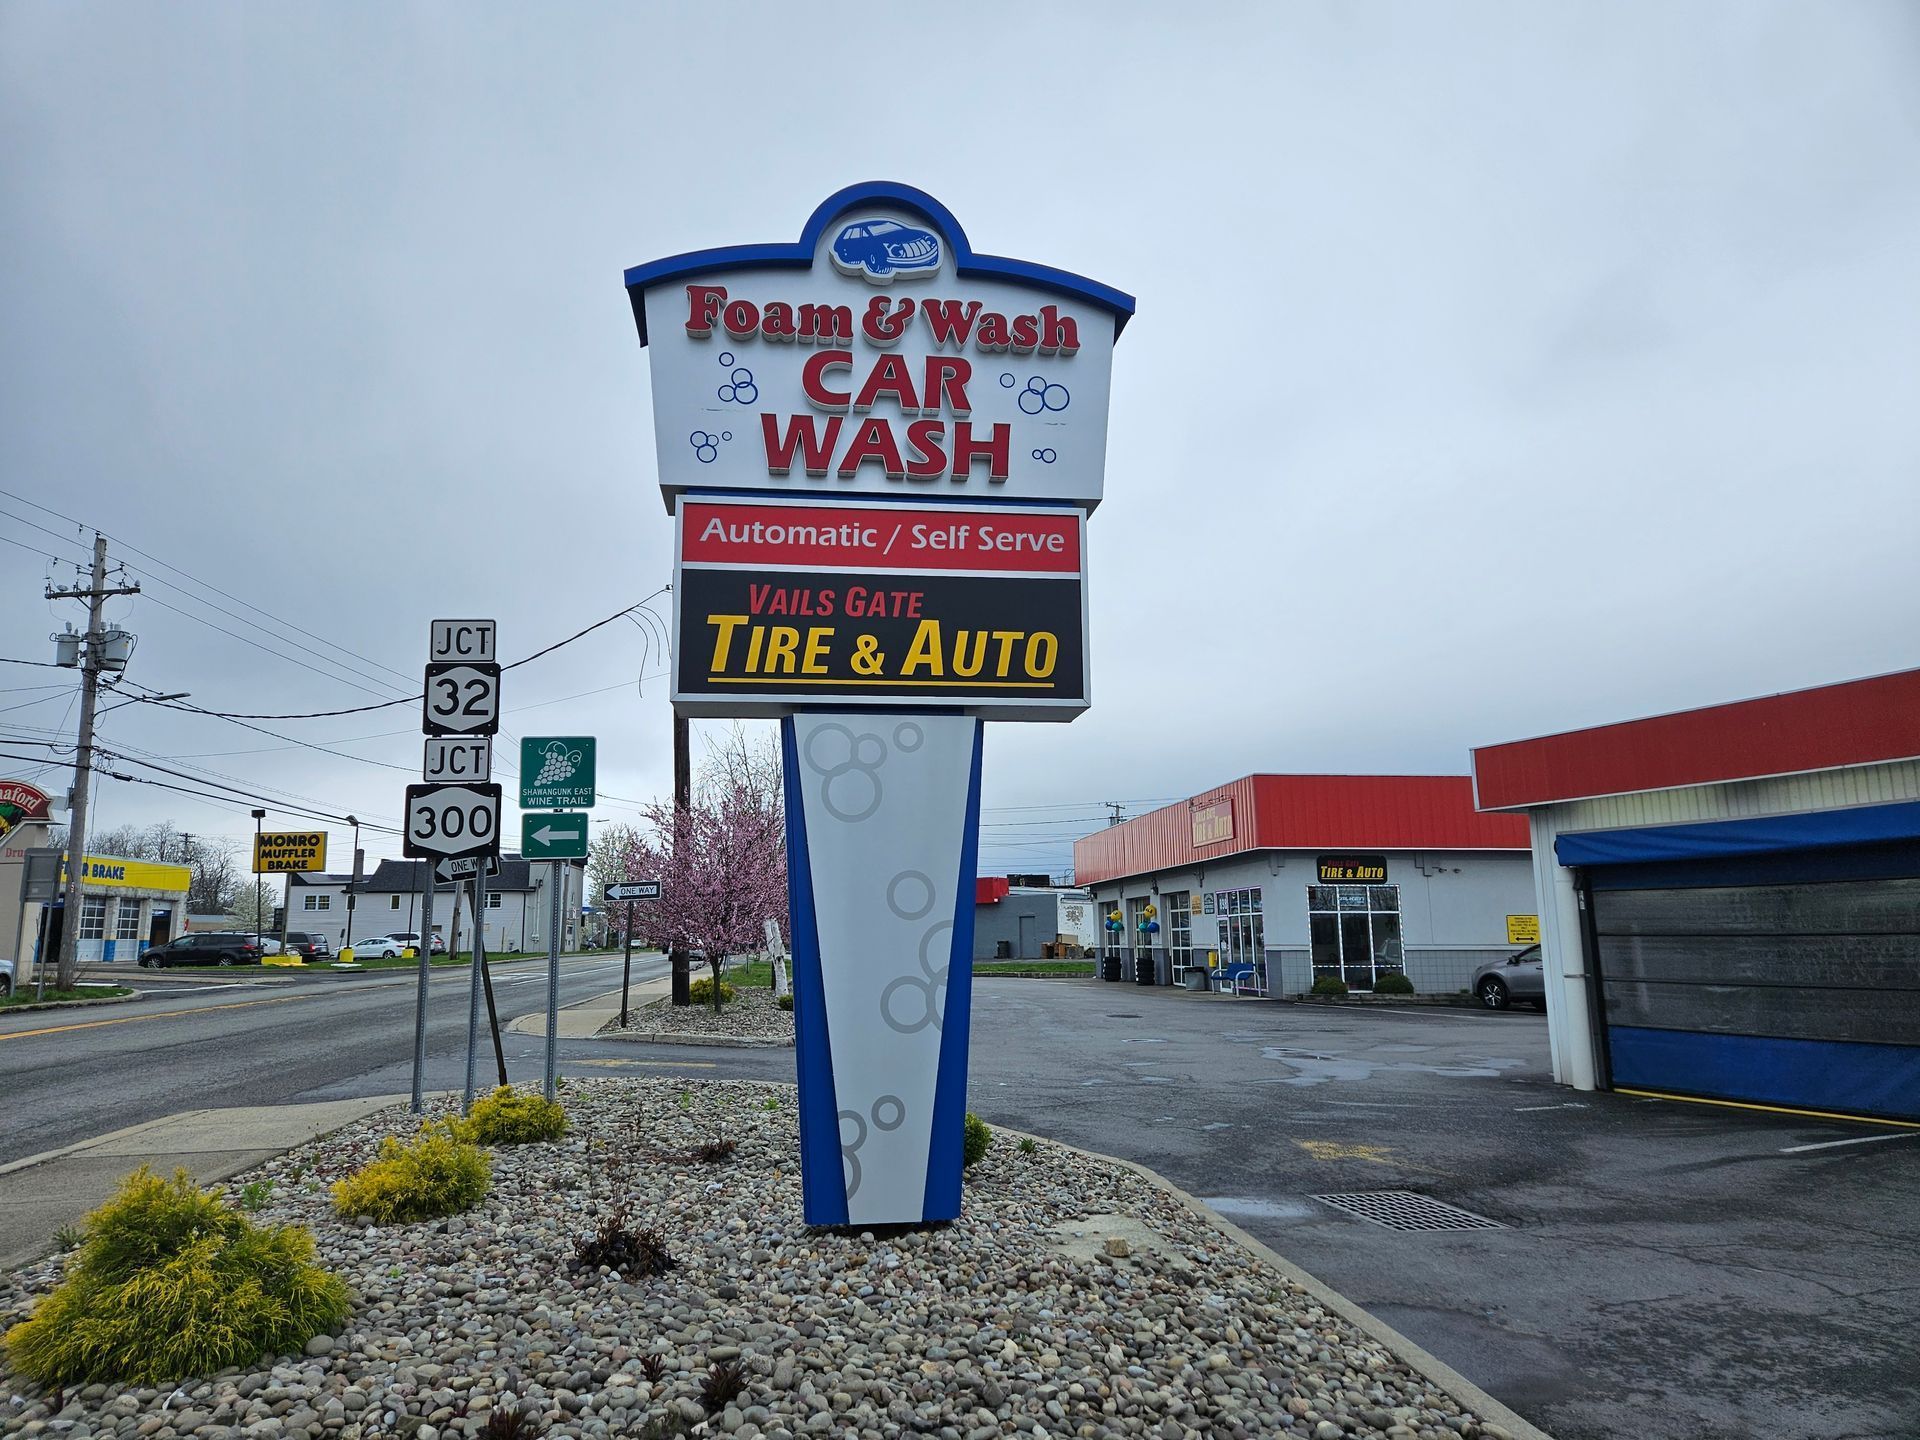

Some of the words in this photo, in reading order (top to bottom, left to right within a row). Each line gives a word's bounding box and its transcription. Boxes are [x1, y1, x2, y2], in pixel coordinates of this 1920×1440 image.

[685, 285, 854, 343] Foam
[861, 295, 916, 344] &
[920, 298, 1080, 352] Wash
[802, 350, 972, 413] CAR
[760, 412, 1011, 480] WASH
[699, 517, 878, 548] Automatic
[883, 524, 902, 555] /
[911, 524, 971, 550] Self
[978, 526, 1065, 553] Serve
[749, 584, 836, 617] VAILS
[844, 586, 924, 618] GATE
[436, 627, 491, 655] JCT
[707, 614, 835, 674] TIRE
[850, 634, 885, 675] &
[900, 619, 1059, 679] AUTO
[433, 678, 491, 716] 32
[429, 746, 486, 775] JCT
[522, 788, 572, 796] SHAWANGUNK
[574, 787, 593, 795] EAST
[527, 797, 553, 805] WINE
[557, 797, 588, 805] TRAIL
[414, 805, 493, 839] 300
[260, 834, 320, 847] MONRO
[5, 847, 24, 858] Dru
[261, 848, 316, 859] MUFFLER
[92, 863, 125, 880] BRAKE
[267, 860, 308, 870] BRAKE
[450, 859, 470, 873] ONE
[1321, 865, 1343, 878] TIRE
[1346, 868, 1353, 878] &
[1356, 865, 1384, 878] AUTO
[620, 887, 637, 896] ONE
[638, 886, 655, 895] WAY
